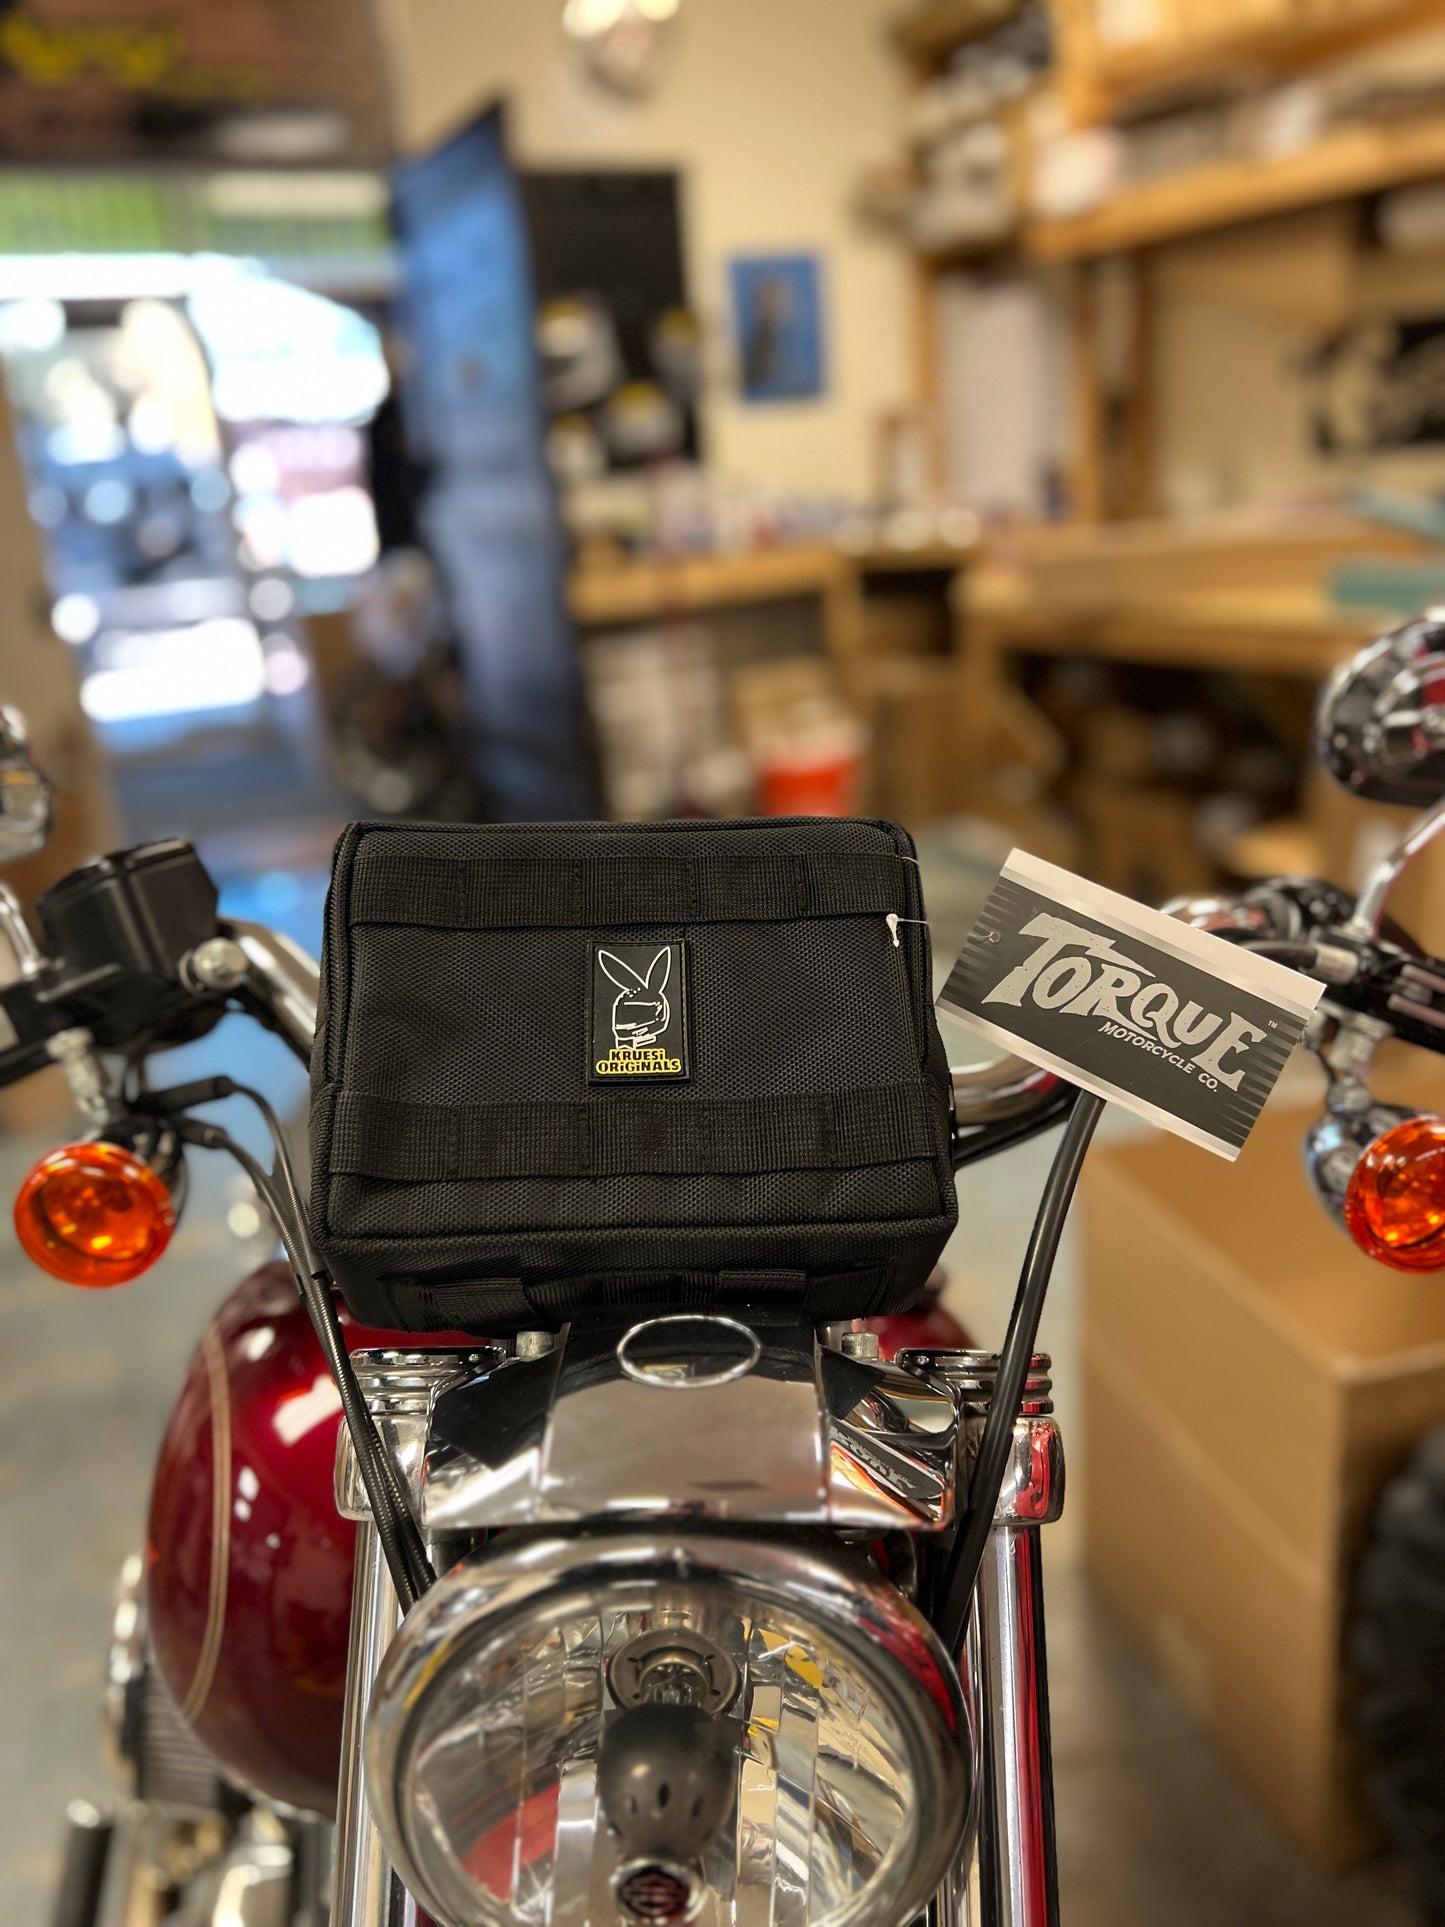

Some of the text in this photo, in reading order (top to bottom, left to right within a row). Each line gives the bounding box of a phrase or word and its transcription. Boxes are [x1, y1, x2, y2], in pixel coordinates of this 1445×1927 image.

[982, 912, 1267, 1091] TORQUE
[1098, 1021, 1218, 1092] MOTORCYCLE CO.
